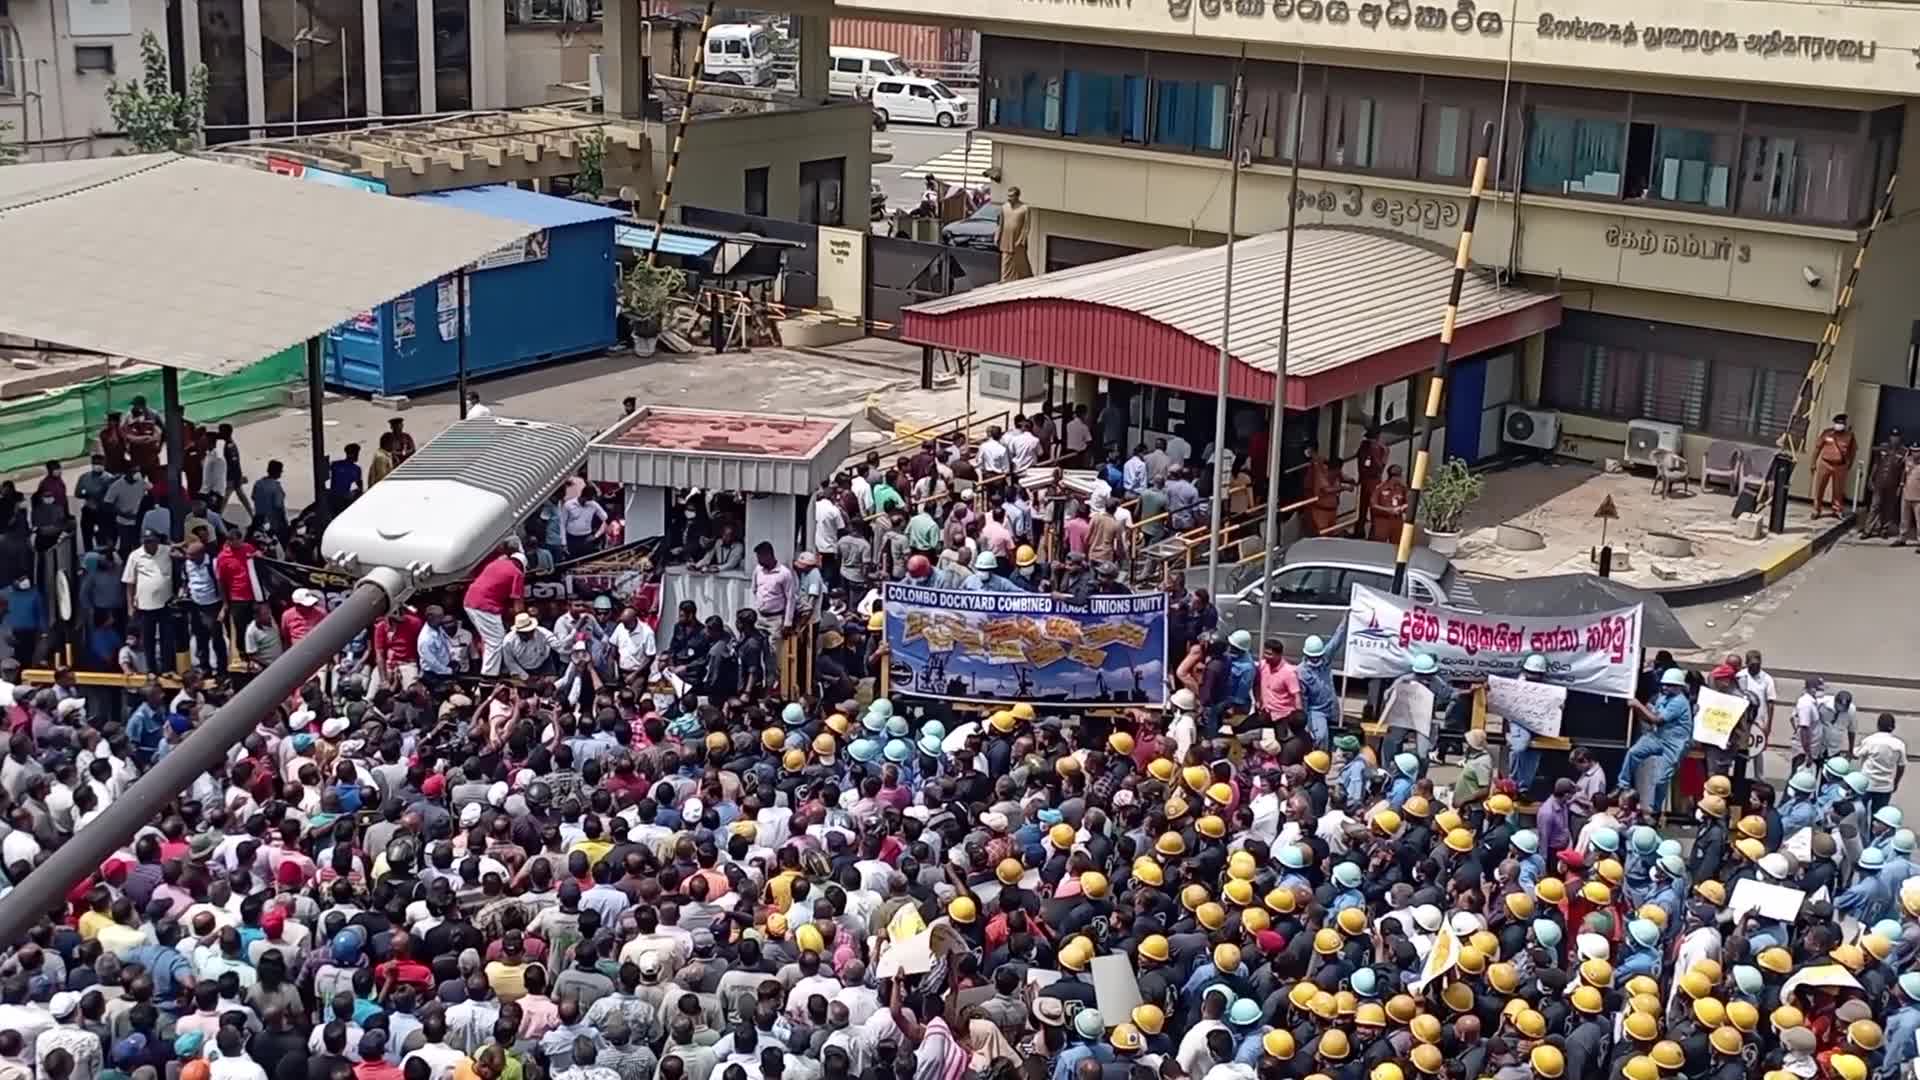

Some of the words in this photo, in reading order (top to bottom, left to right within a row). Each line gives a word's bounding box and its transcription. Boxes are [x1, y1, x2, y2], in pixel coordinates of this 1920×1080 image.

[1343, 184, 1363, 217] 3
[1738, 245, 1751, 263] 3
[888, 586, 937, 604] COLOMBO
[940, 593, 995, 611] DOCKYARD
[997, 597, 1052, 612] COMBINED
[1091, 599, 1130, 613] UNIONS
[1133, 595, 1163, 611] UNITY
